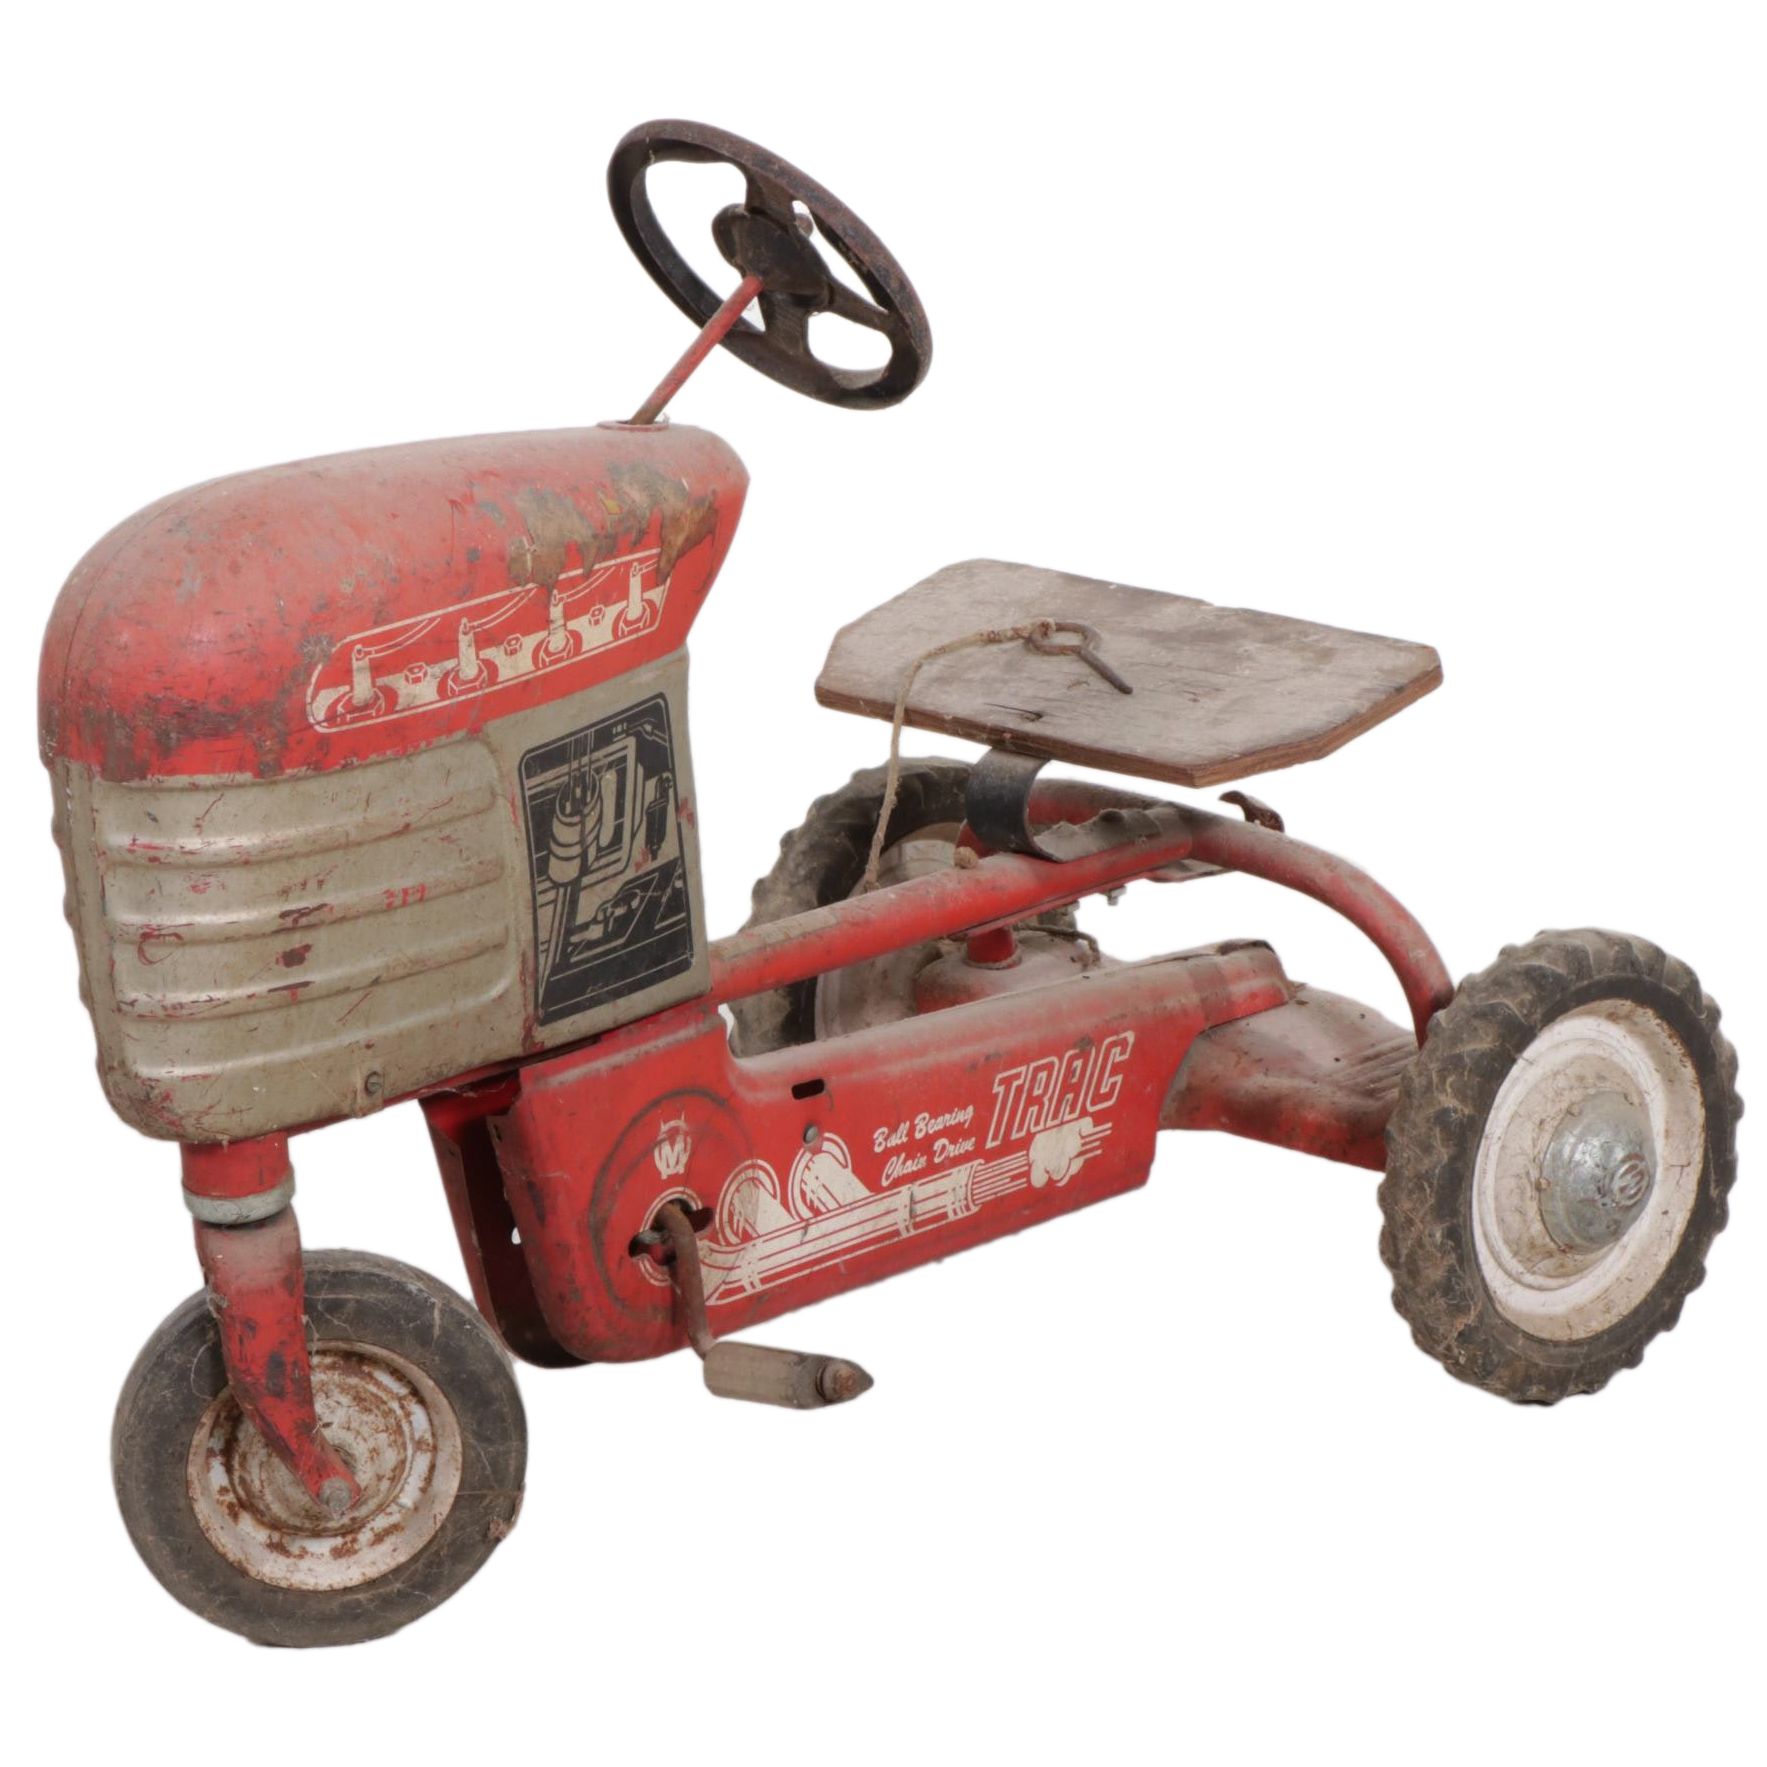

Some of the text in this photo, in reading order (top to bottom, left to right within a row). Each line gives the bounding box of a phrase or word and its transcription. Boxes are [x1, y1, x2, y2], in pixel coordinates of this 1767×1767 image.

[985, 1031, 1135, 1149] TRAC
[873, 1104, 975, 1153] Ball Bearing
[881, 1137, 976, 1187] Chain Drive
